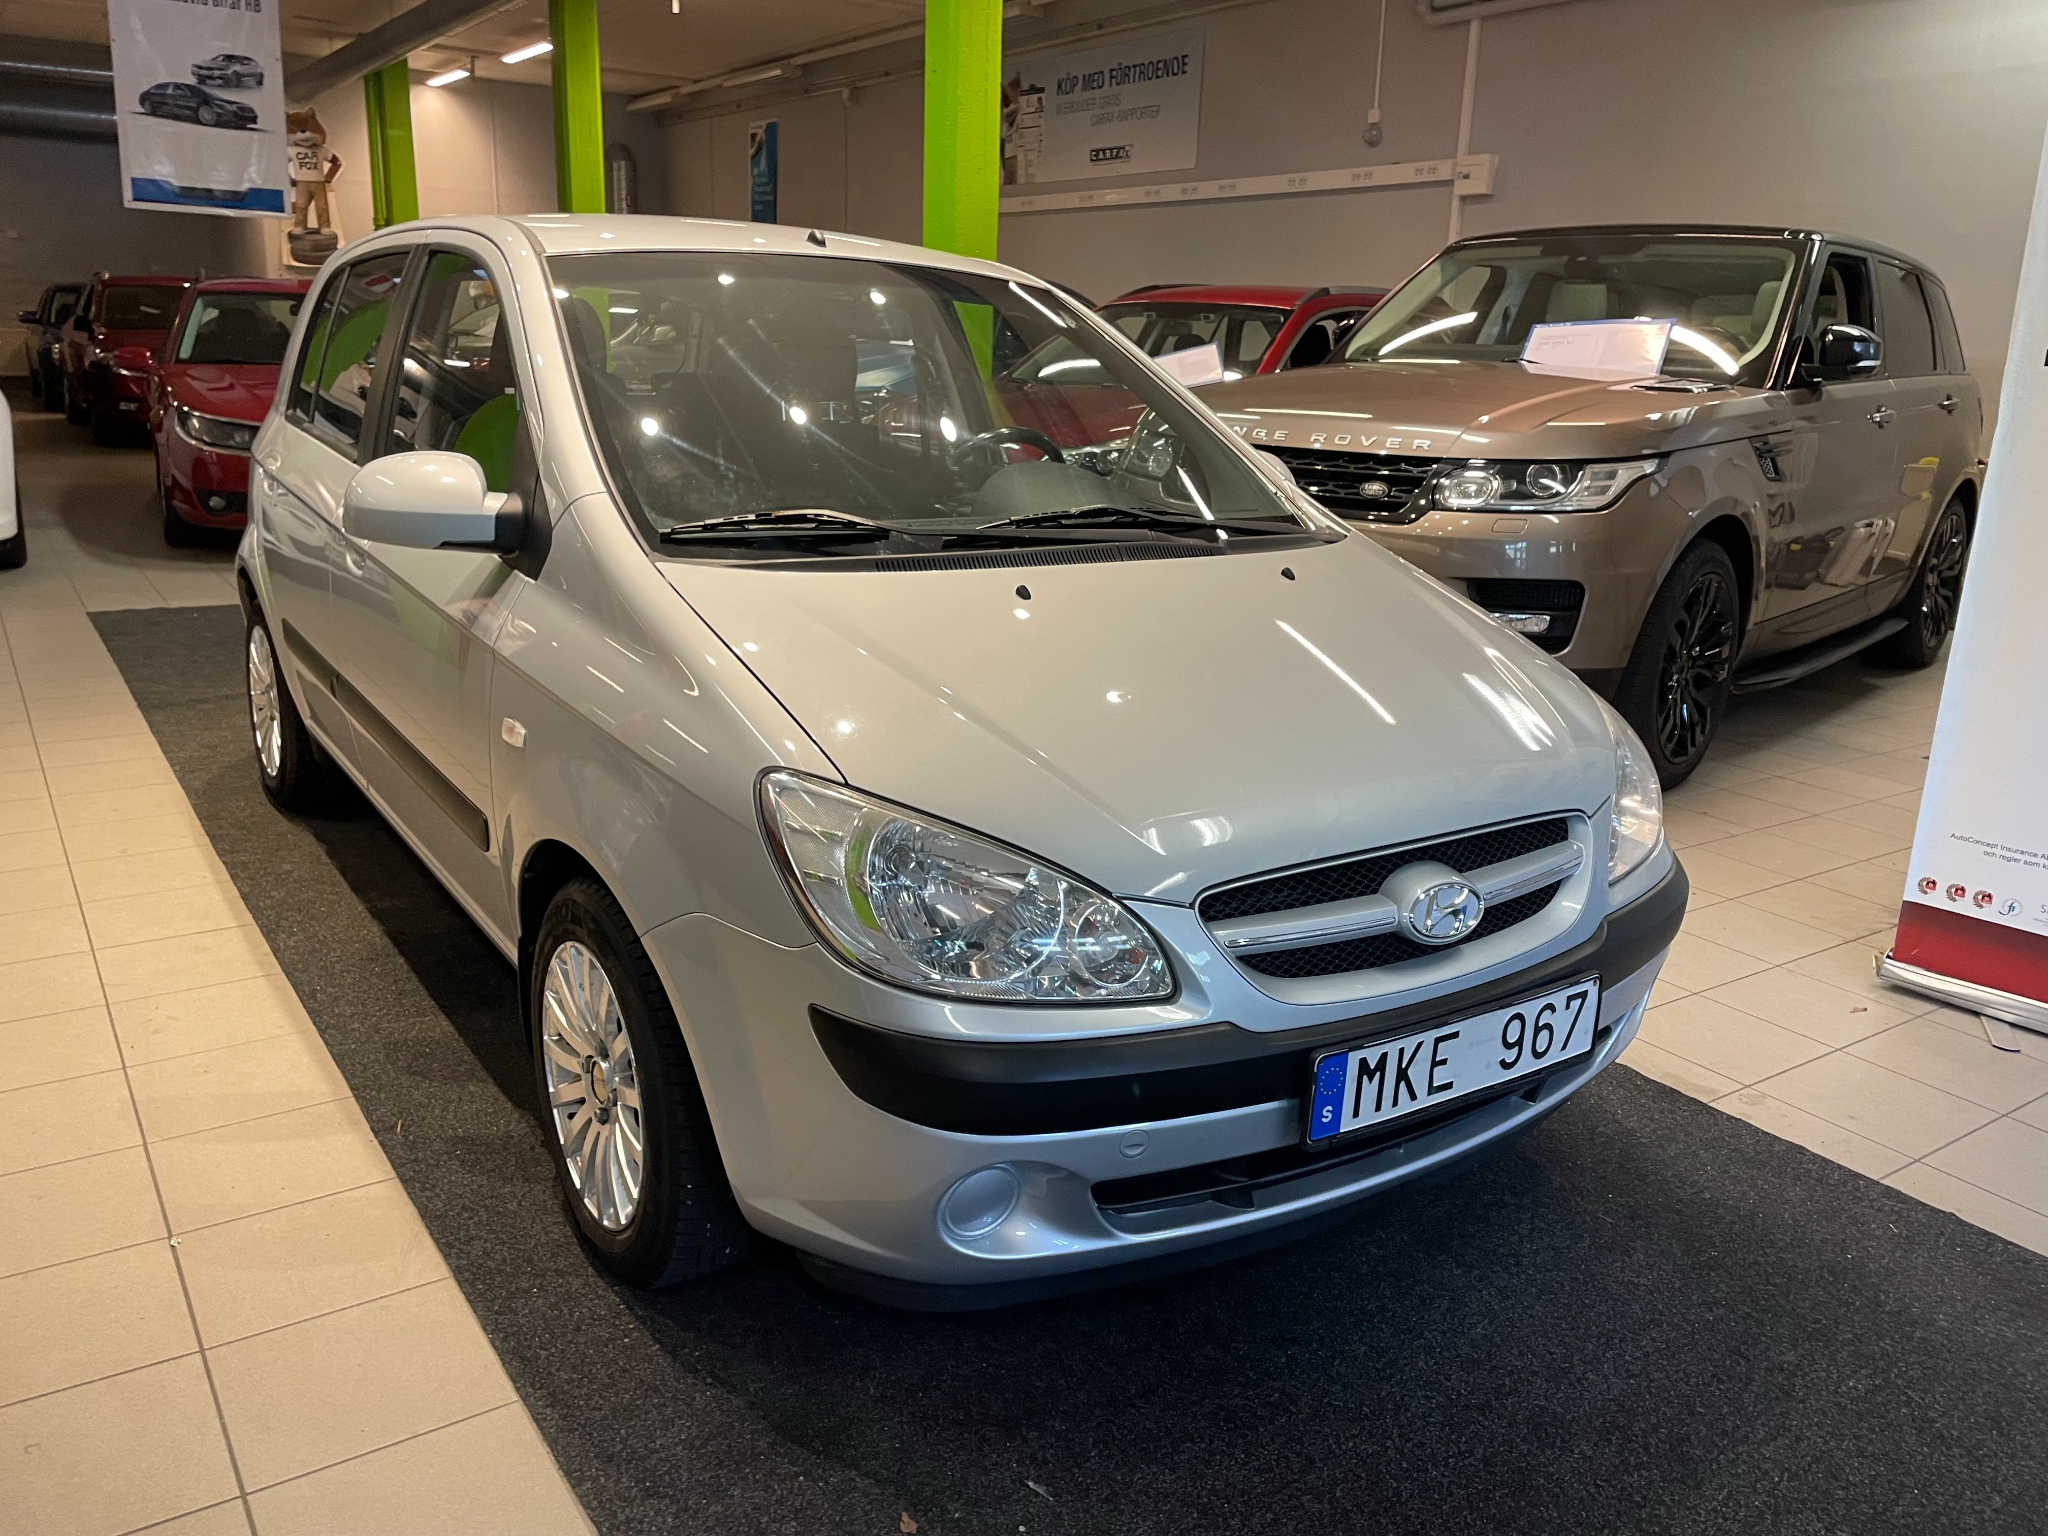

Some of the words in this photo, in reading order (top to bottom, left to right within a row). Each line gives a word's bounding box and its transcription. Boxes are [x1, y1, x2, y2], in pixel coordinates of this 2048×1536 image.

[1056, 72, 1079, 96] KÖP
[1081, 70, 1105, 92] MED
[1109, 54, 1189, 88] FÖRTROENDE
[296, 151, 318, 160] CAR
[1231, 425, 1290, 441] NGE
[1310, 432, 1432, 451] ROVER
[1950, 832, 1999, 850] AutoConcept
[2000, 844, 2039, 859] Insurance
[1983, 850, 1997, 859] och
[1999, 853, 2022, 863] regler
[2023, 859, 2041, 868] som
[1352, 1030, 1461, 1120] MKE
[1499, 989, 1589, 1071] 967
[1321, 1105, 1334, 1123] S
